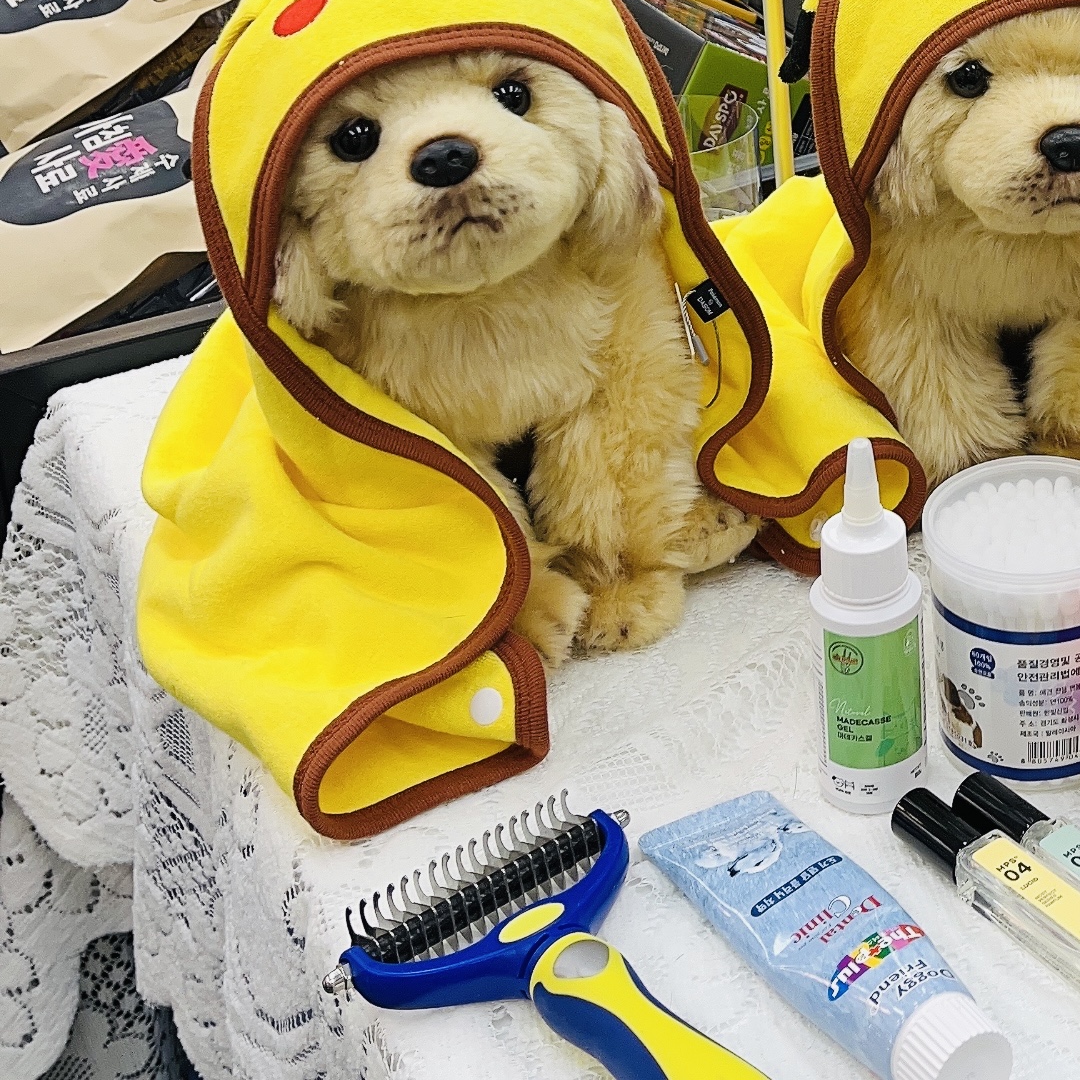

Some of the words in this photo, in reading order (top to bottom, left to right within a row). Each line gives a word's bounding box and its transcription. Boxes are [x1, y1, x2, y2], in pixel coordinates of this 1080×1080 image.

[1016, 668, 1080, 683] 안전관리법에
[836, 715, 892, 726] MADECASSE
[837, 724, 854, 733] GEL
[1004, 861, 1032, 882] 04
[791, 895, 852, 945] Clinic
[869, 959, 929, 1007] Friend
[896, 968, 956, 1002] Doggy
